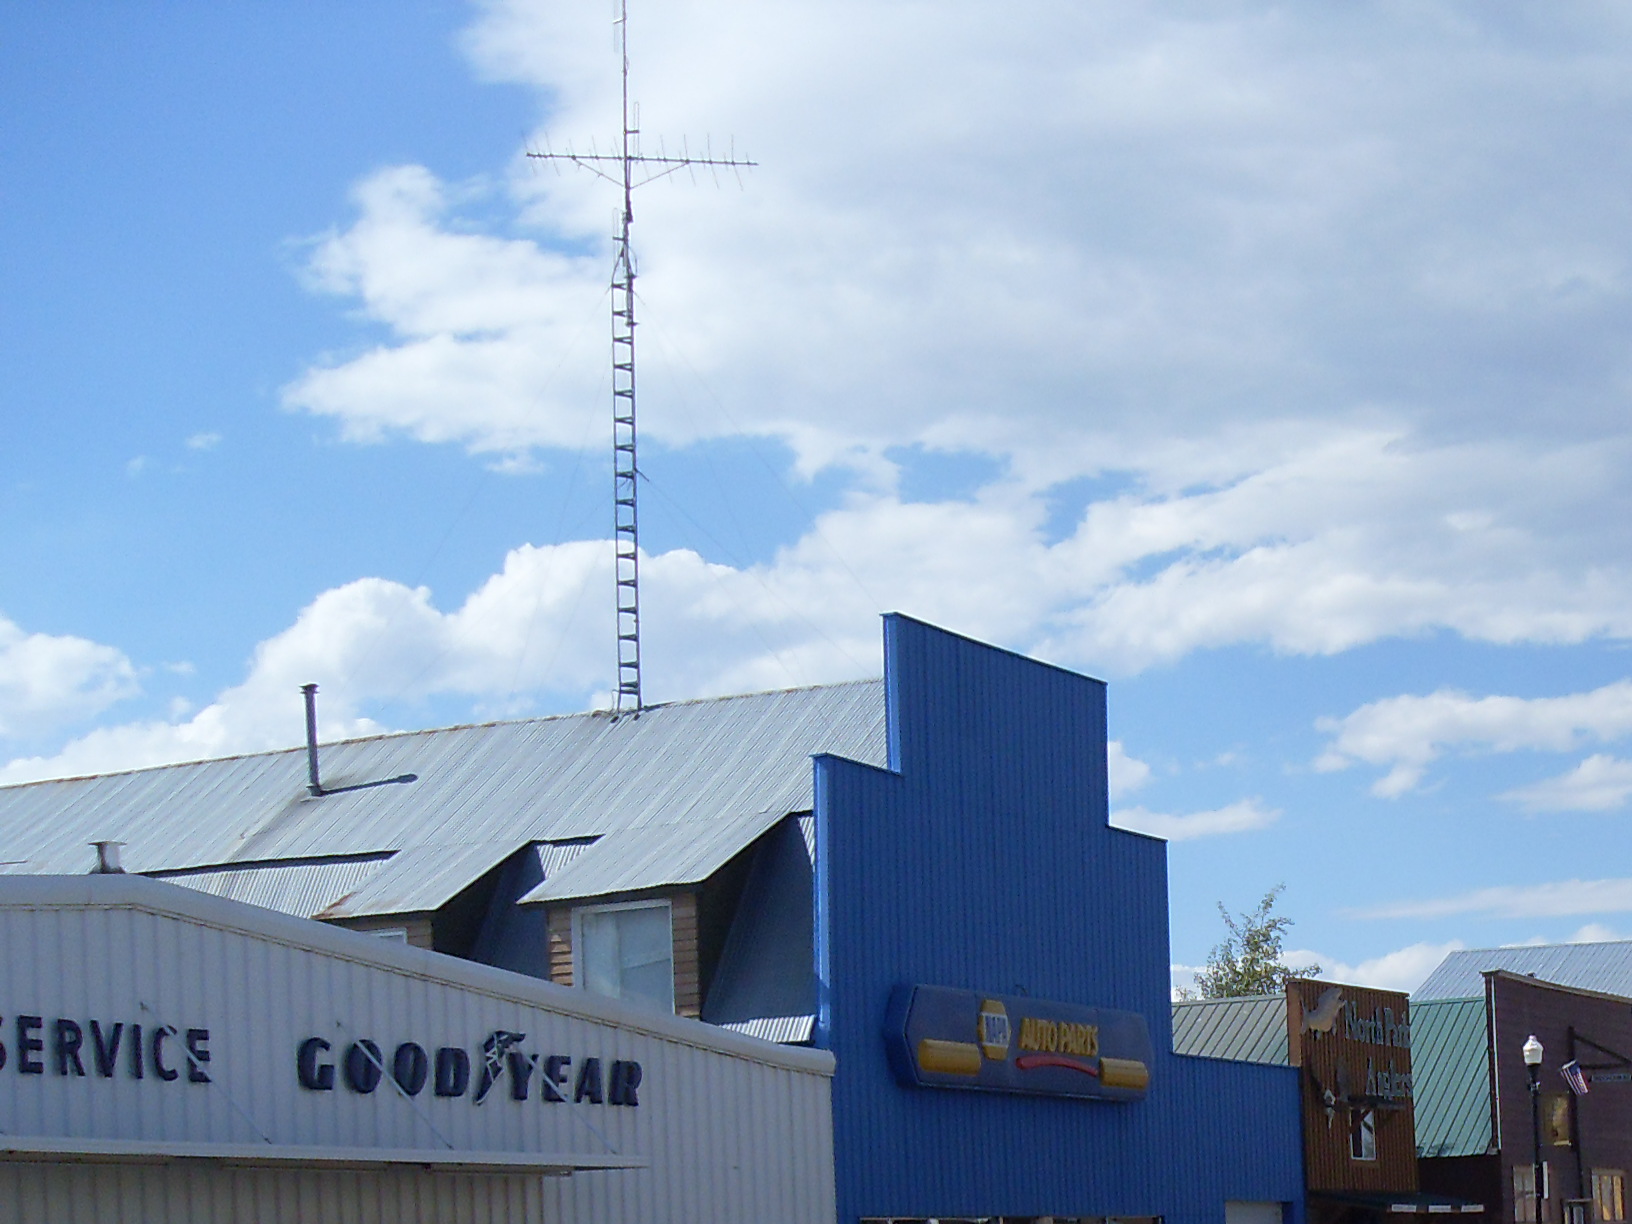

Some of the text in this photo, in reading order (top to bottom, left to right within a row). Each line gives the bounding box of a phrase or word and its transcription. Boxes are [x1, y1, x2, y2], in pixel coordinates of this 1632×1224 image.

[983, 1014, 1008, 1047] NAPA
[1019, 1017, 1099, 1057] AUTO PARTS
[1344, 999, 1384, 1045] North
